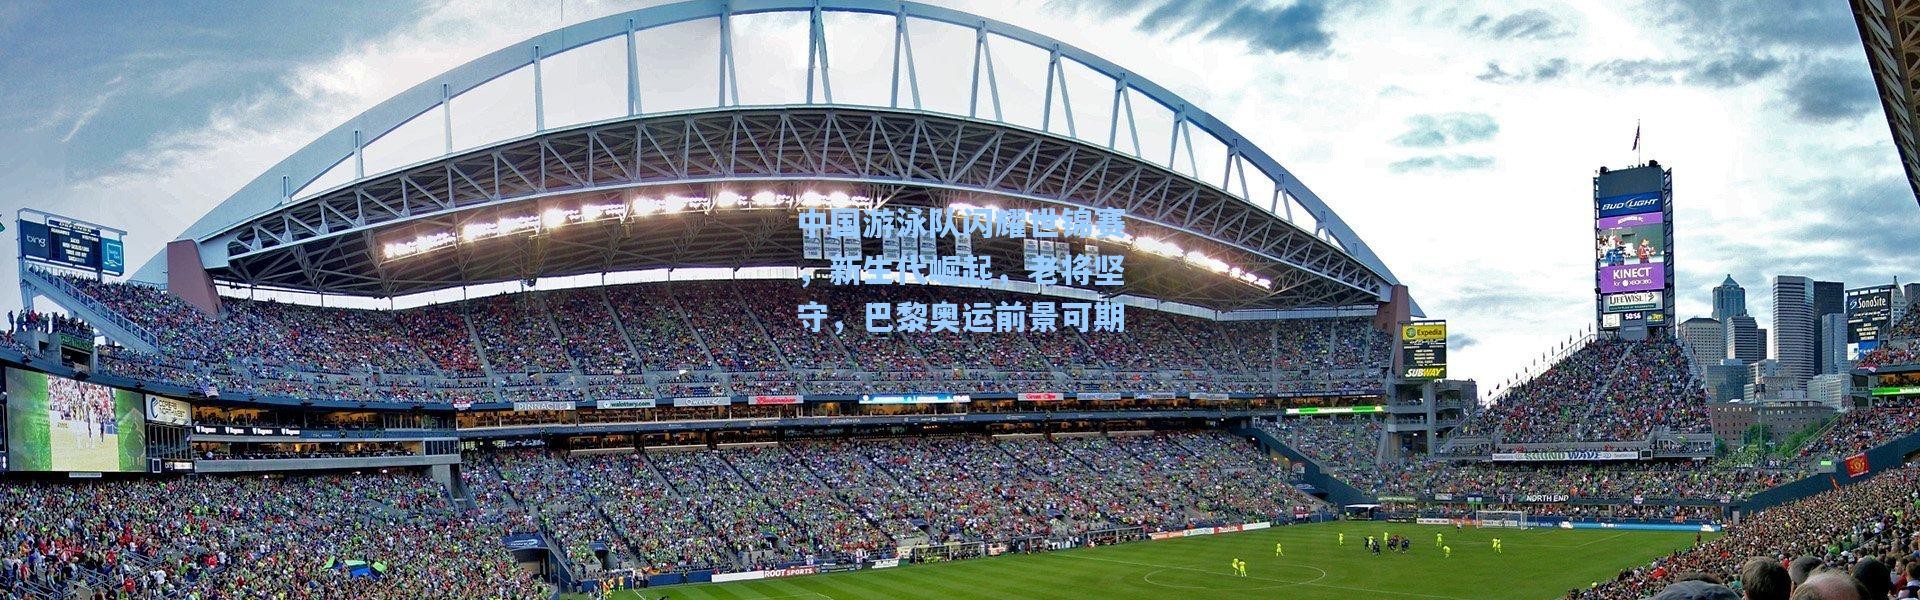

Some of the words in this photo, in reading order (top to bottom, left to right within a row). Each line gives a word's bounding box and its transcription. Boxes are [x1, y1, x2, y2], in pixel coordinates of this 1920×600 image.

[1602, 202, 1625, 211] BUD
[1628, 199, 1659, 208] LIGHT
[26, 234, 46, 248] bing
[1613, 267, 1652, 279] KINECT
[1858, 295, 1886, 309] SonoSite
[1416, 329, 1442, 337] Expedia
[1405, 368, 1445, 378] SUBWAY
[1527, 494, 1551, 502] NORTH
[1554, 494, 1569, 502] END
[764, 570, 786, 578] ROOT
[786, 567, 815, 576] SPORTS
